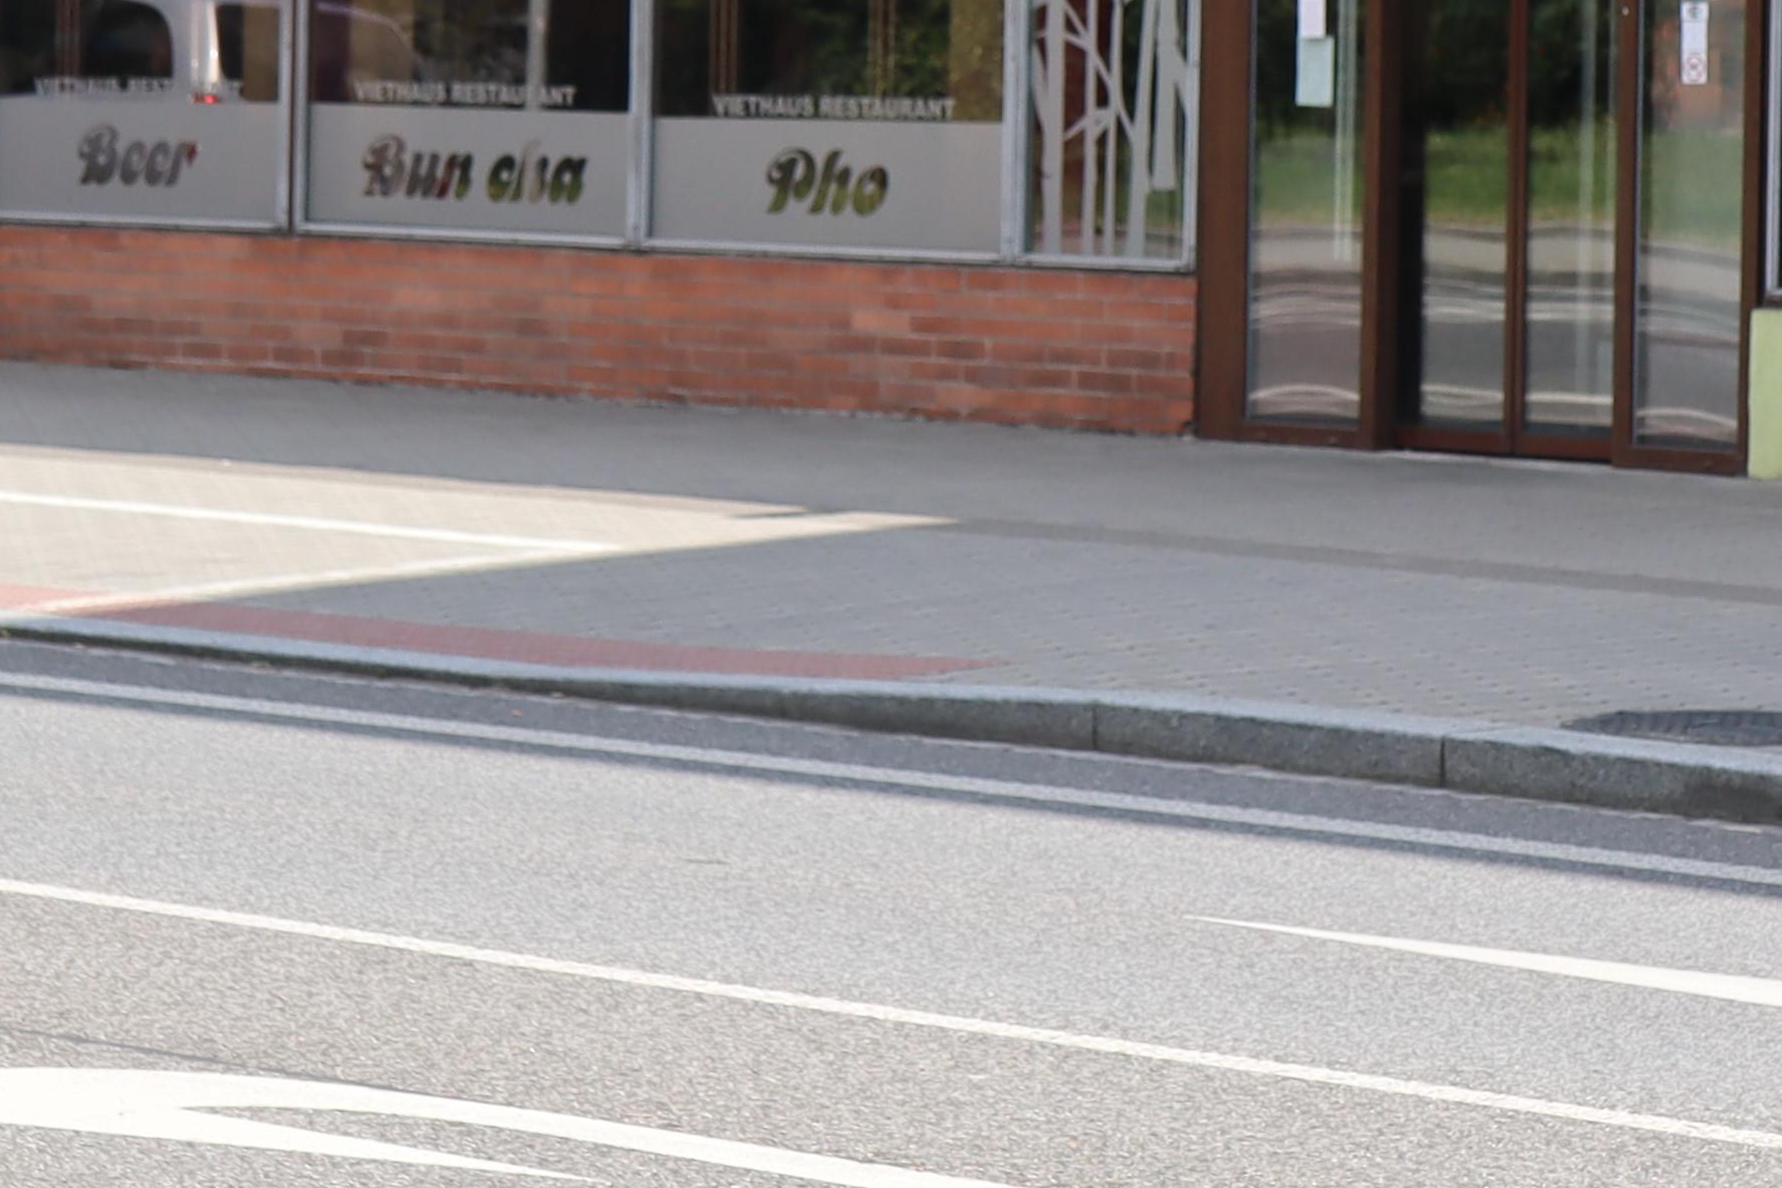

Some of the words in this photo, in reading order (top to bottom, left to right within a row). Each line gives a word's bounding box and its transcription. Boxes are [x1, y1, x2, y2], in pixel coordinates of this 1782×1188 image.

[354, 81, 447, 103] VIETHAUS
[712, 94, 815, 117] VIETHAUS
[818, 95, 955, 121] RESTAURANT
[77, 124, 198, 188] Beer
[362, 133, 474, 201] Bun
[765, 147, 889, 218] Pho
